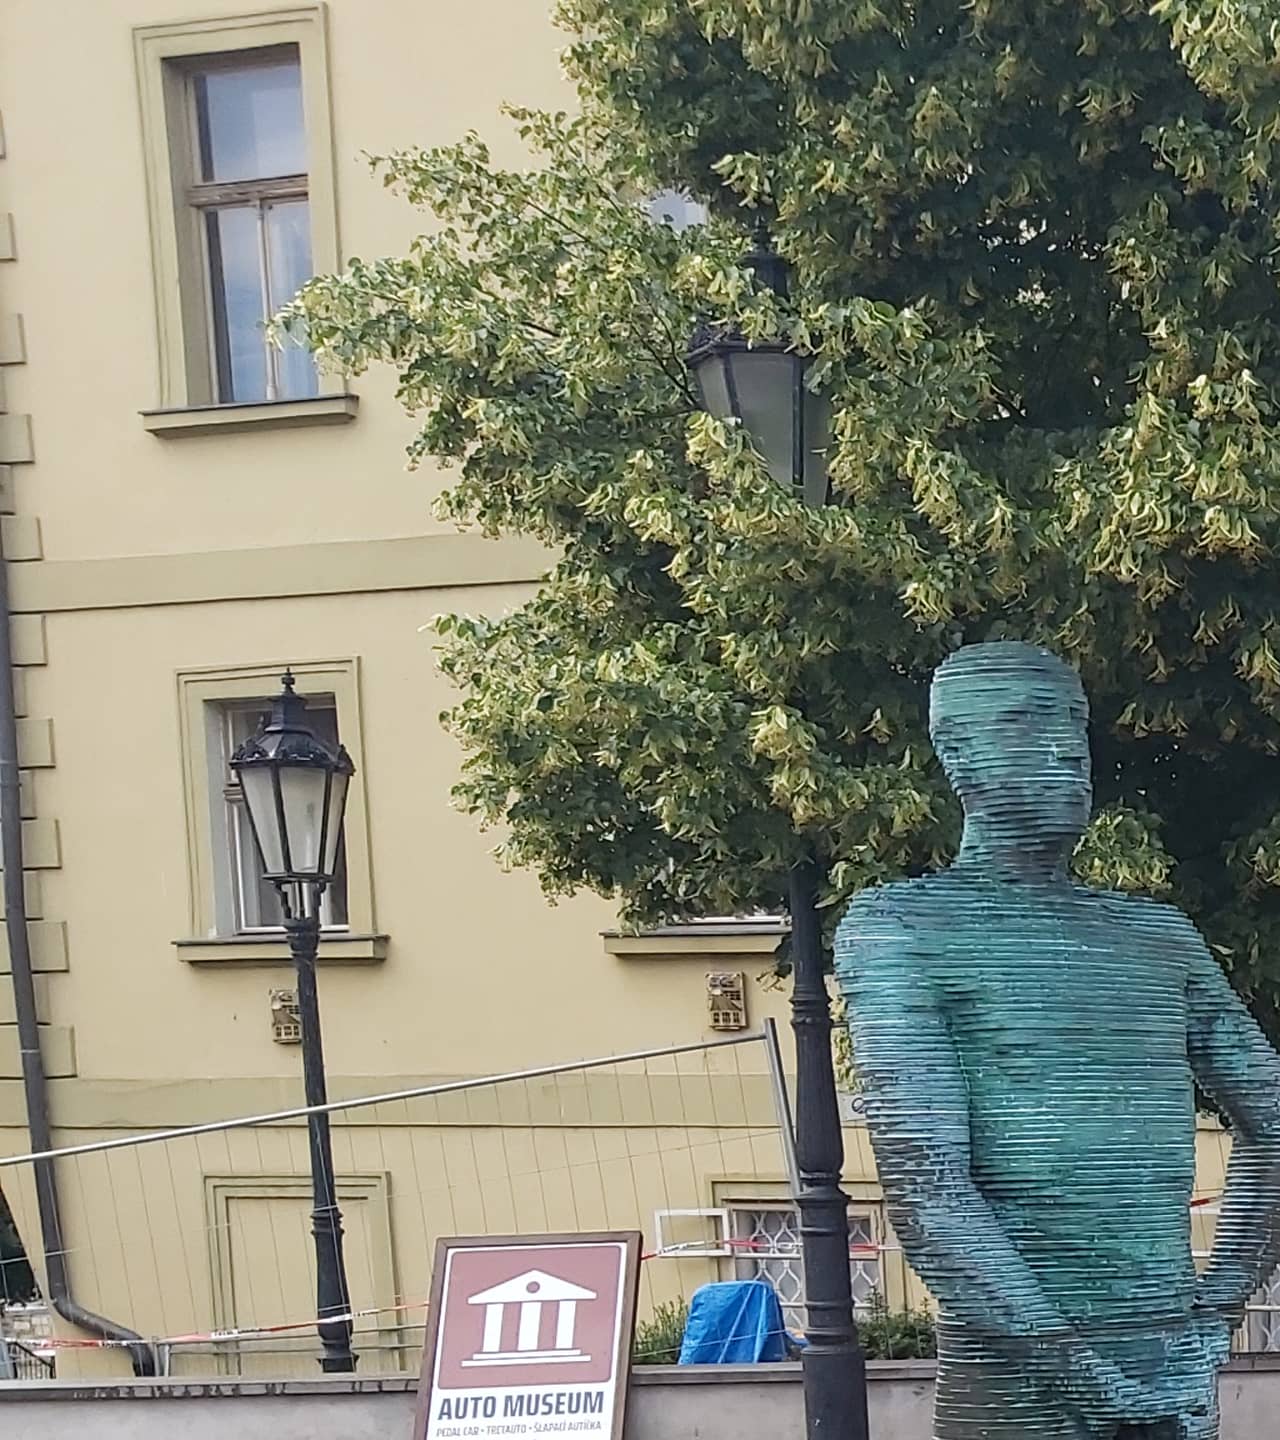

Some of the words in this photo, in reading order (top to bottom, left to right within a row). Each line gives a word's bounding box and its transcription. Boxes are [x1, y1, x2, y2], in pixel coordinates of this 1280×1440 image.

[437, 1395, 497, 1420] AUTO
[503, 1391, 604, 1417] MUSEUM
[436, 1427, 461, 1437] PEDAL
[463, 1426, 480, 1436] CAR
